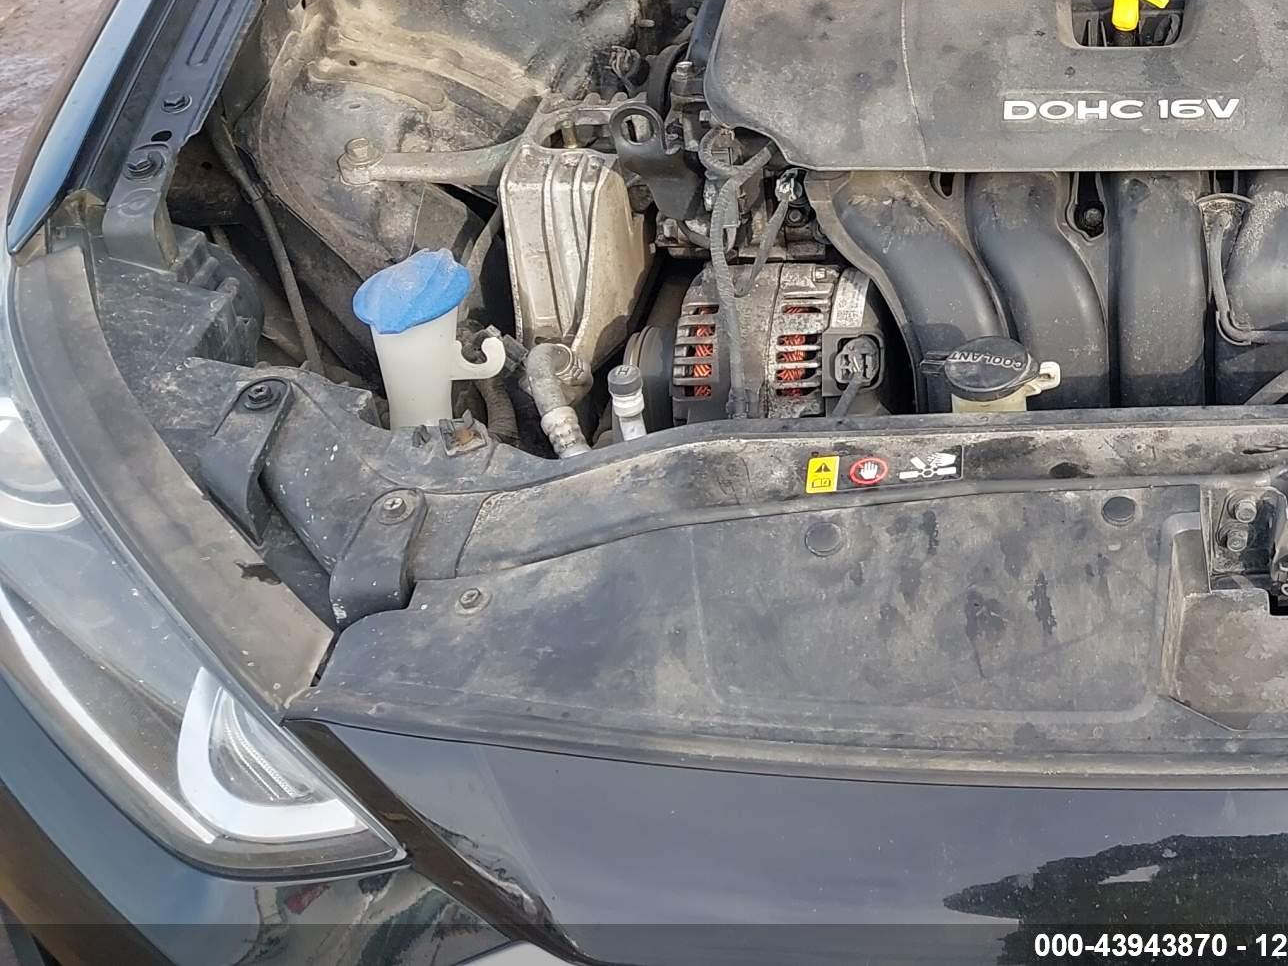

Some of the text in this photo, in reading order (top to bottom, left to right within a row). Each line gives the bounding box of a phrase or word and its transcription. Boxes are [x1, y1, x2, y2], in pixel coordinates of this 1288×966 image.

[1003, 98, 1240, 120] DOHC 16V
[947, 351, 1025, 370] COOLANT
